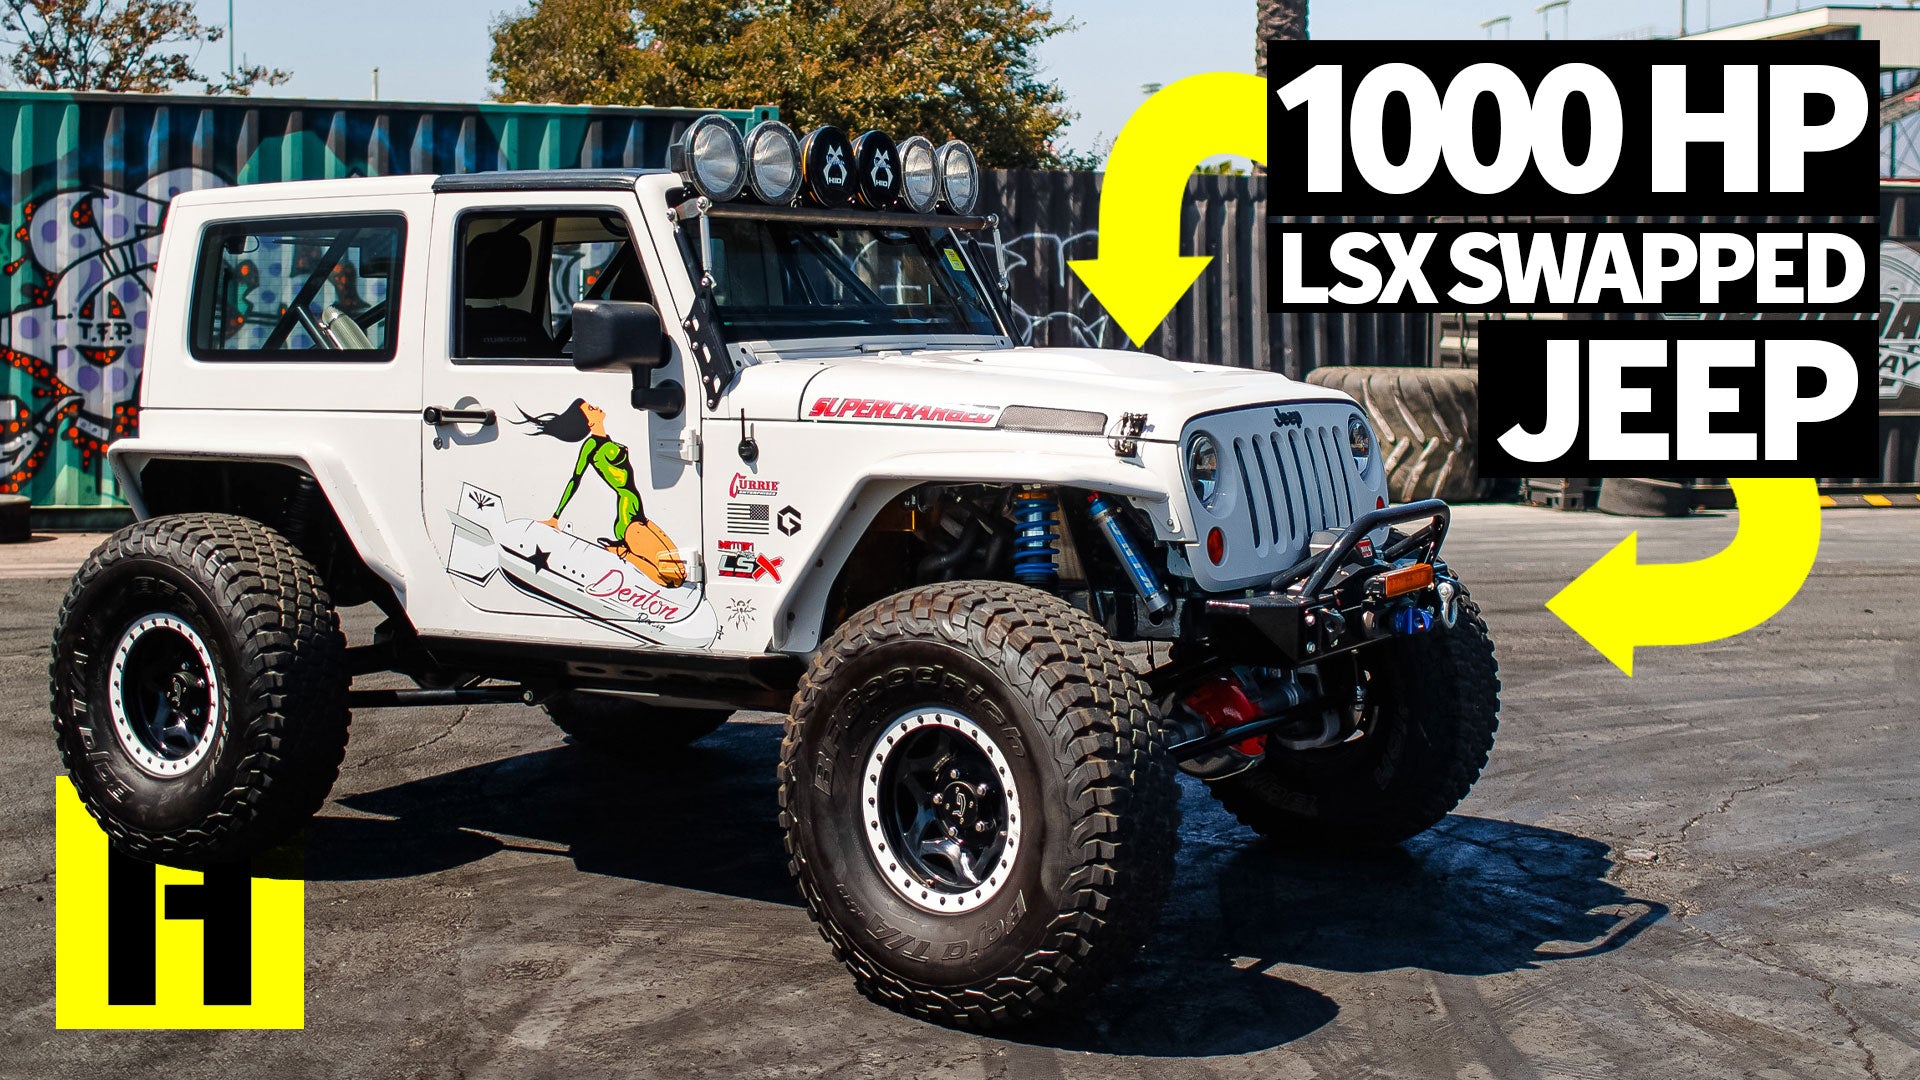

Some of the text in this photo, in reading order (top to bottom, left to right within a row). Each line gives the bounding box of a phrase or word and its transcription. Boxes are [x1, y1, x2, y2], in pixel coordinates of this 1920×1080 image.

[809, 397, 995, 424] SUPERCHARGED
[1273, 408, 1303, 429] Jeep
[729, 472, 778, 498] CURRIE
[718, 552, 784, 584] LSX
[586, 569, 678, 620] Denton
